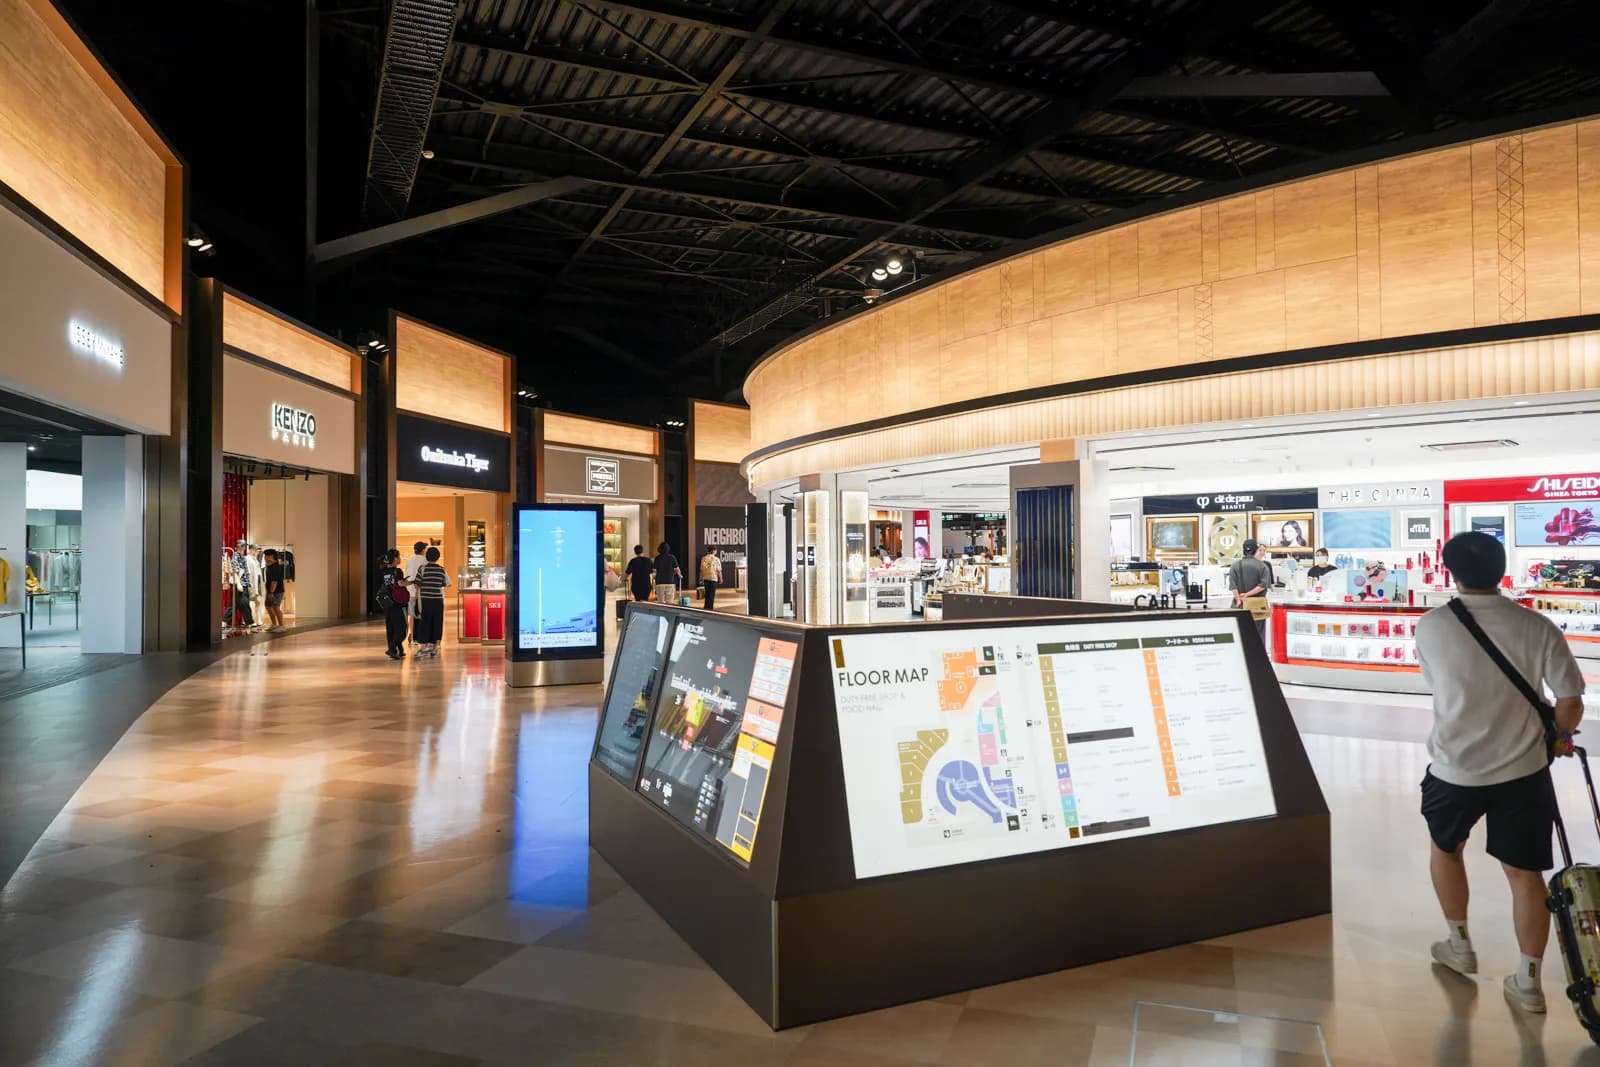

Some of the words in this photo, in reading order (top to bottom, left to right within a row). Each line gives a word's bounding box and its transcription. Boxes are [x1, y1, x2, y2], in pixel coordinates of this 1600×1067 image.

[272, 402, 316, 437] KENZO
[421, 445, 466, 468] Onitsuka
[464, 452, 489, 473] Tiger
[1327, 490, 1362, 503] THE
[1370, 486, 1432, 502] GINZA
[1134, 594, 1178, 609] CART
[838, 669, 891, 687] FLOOR
[895, 667, 929, 684] MAP
